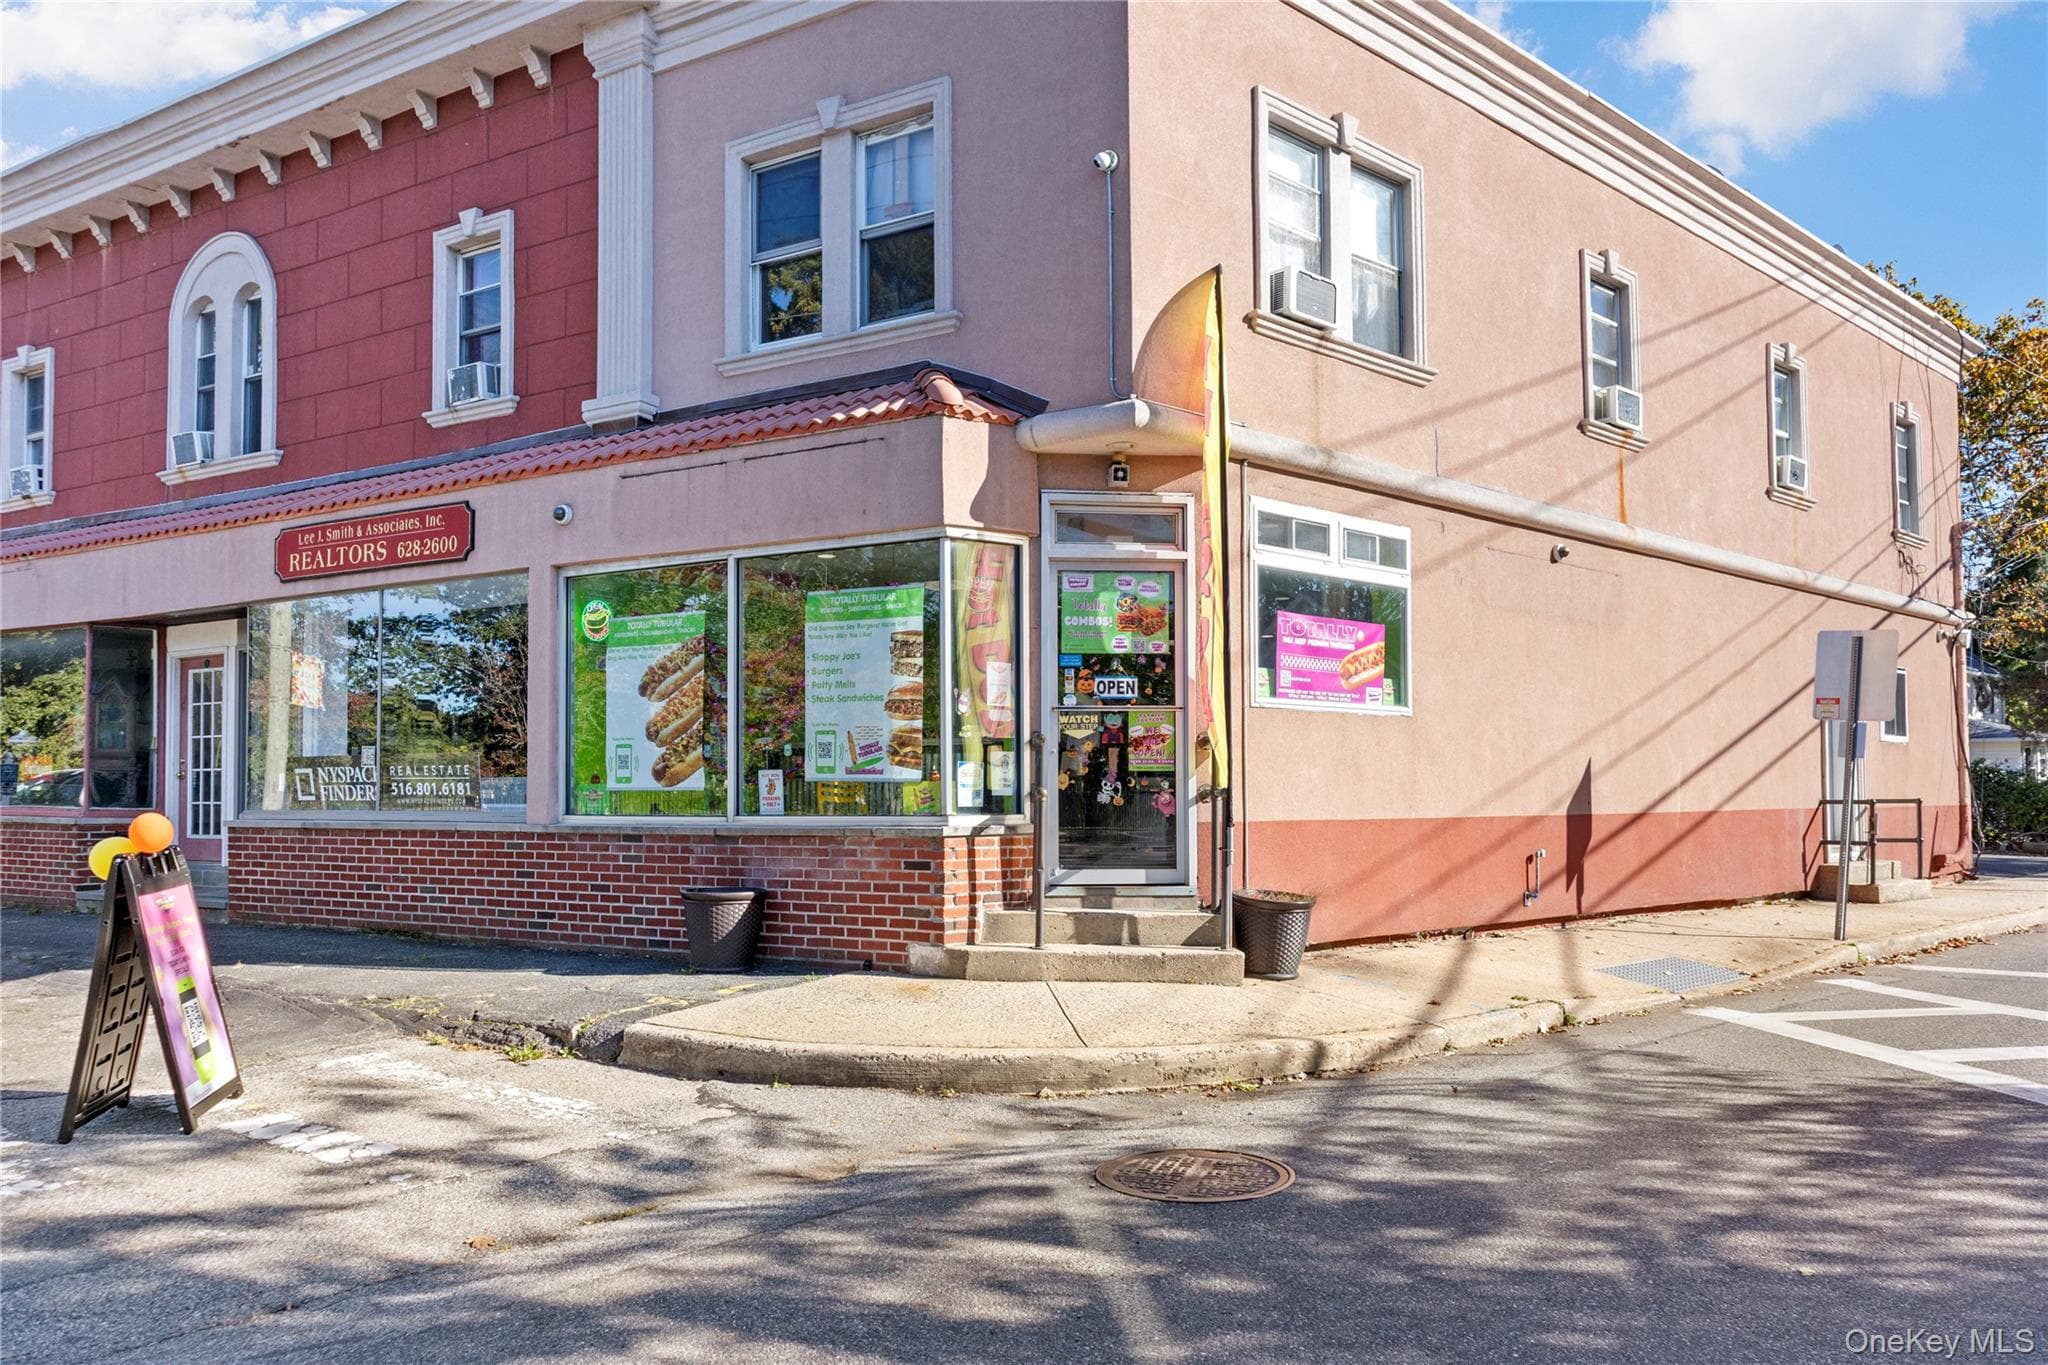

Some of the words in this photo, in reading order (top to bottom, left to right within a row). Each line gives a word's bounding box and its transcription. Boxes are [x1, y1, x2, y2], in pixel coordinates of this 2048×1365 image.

[298, 532, 315, 546] Lee
[326, 524, 354, 542] Smith
[356, 526, 363, 538] &
[425, 514, 446, 528] Inc.
[289, 541, 388, 573] REALTORS
[831, 595, 860, 605] TOTALLY
[861, 592, 898, 602] TUBULAR
[1065, 615, 1113, 628] COMBOS!
[1279, 616, 1357, 642] TOTALLY
[811, 652, 841, 664] Sloppy
[841, 651, 861, 661] Joe's
[811, 667, 844, 677] Burgers
[811, 681, 833, 692] Patty
[834, 680, 856, 689] Melts
[1096, 680, 1136, 695] OPEN
[811, 694, 835, 704] Steak
[836, 693, 884, 703] Sandwiches
[1060, 714, 1098, 724] WATCH
[389, 765, 420, 776] REAL
[423, 764, 471, 776] ESTATE
[391, 782, 471, 796] 516.801.6181
